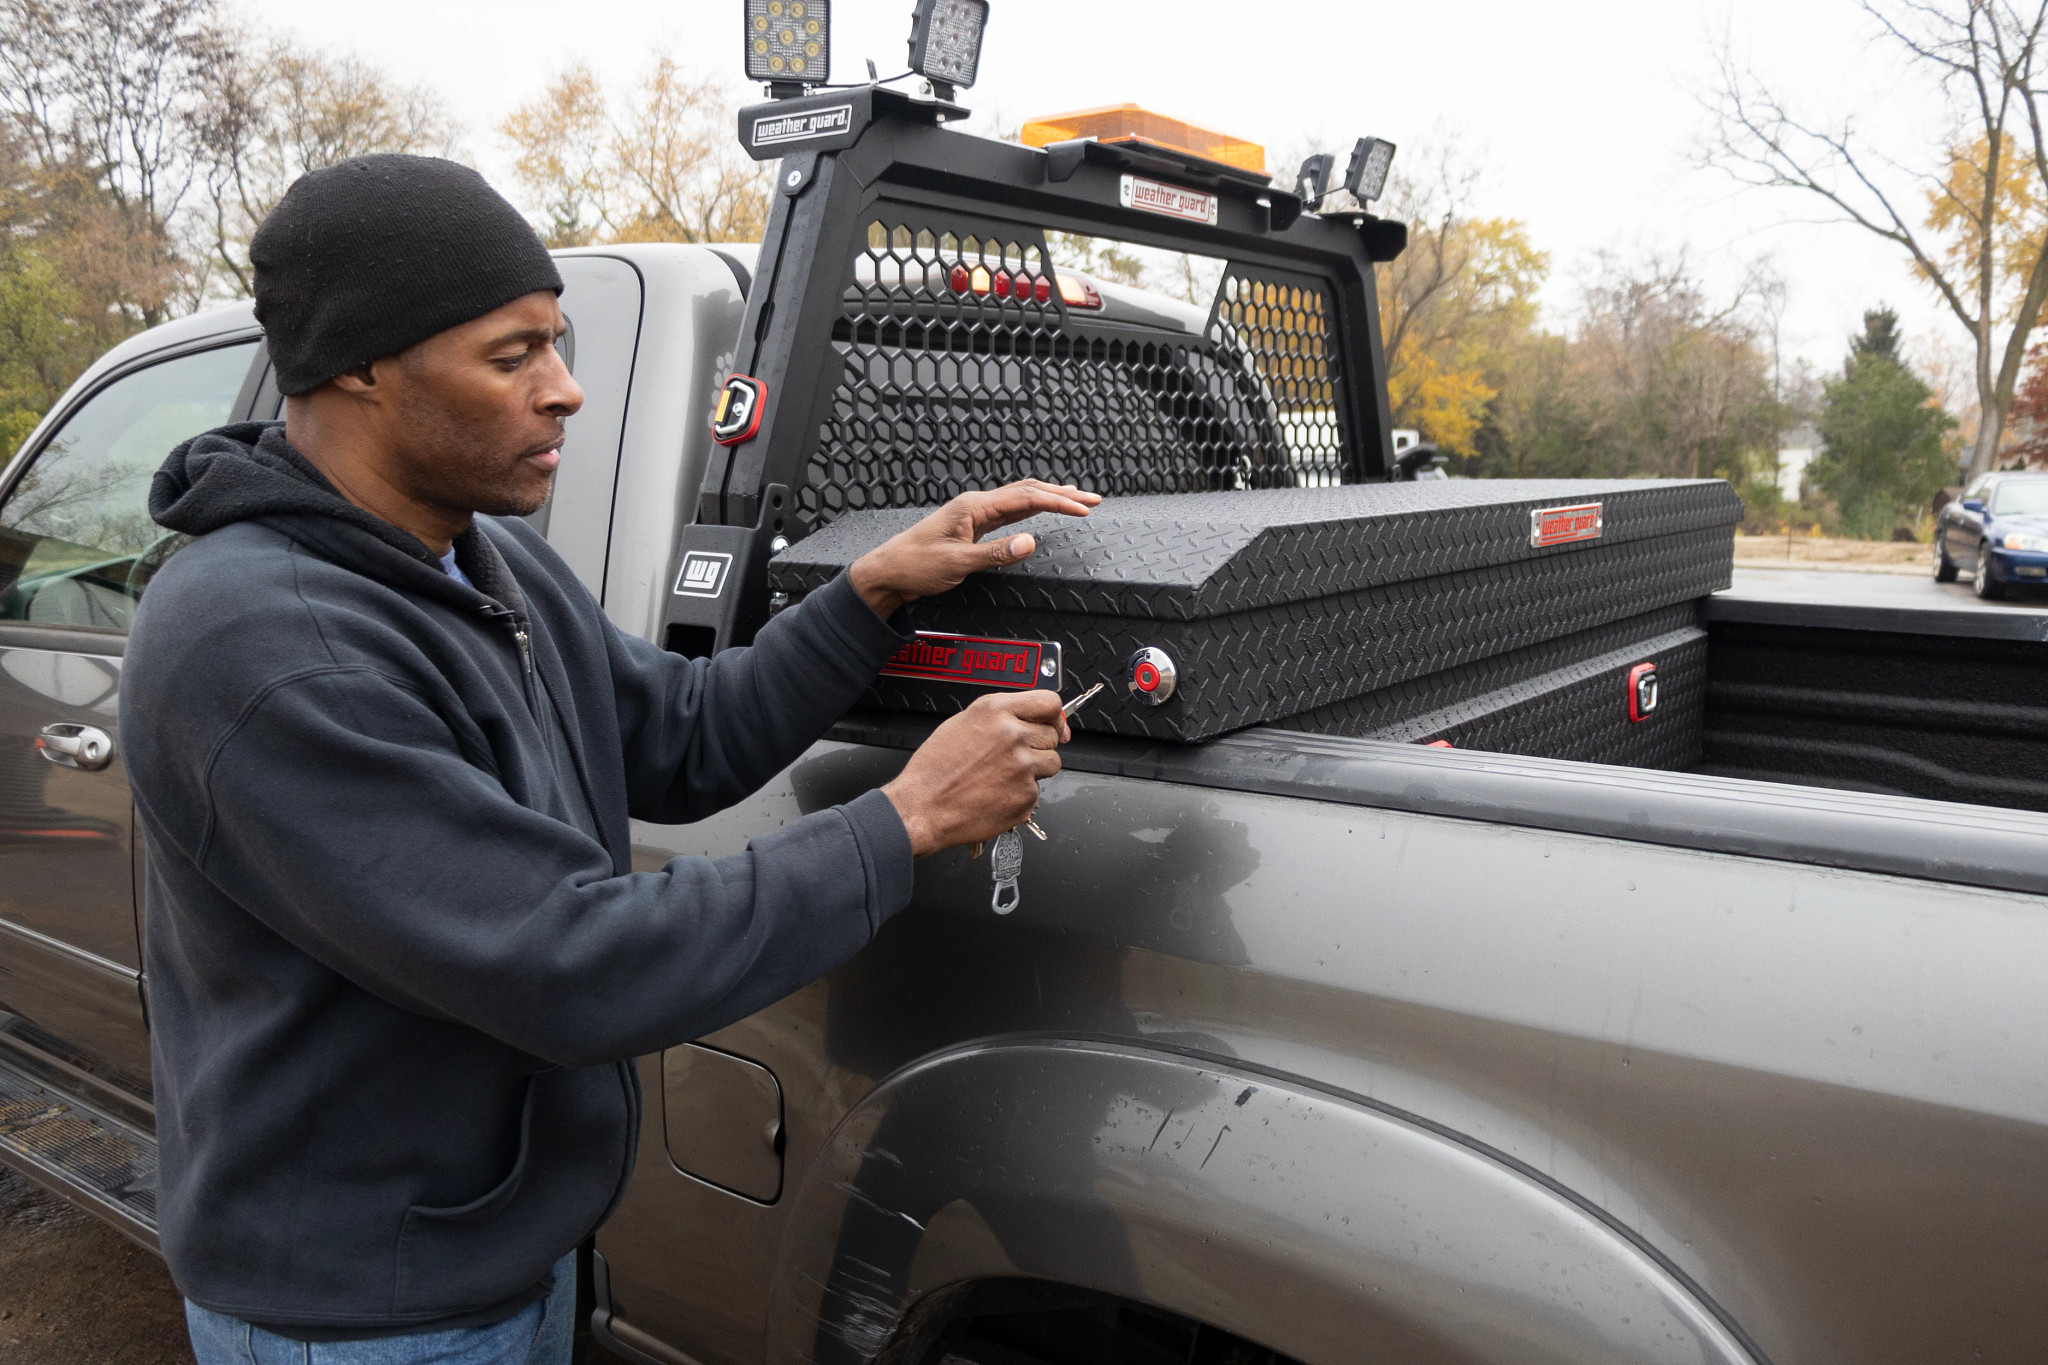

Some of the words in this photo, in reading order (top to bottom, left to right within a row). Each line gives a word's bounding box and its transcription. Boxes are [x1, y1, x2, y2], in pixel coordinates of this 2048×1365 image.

[757, 118, 808, 138] weather
[1135, 185, 1177, 206] weather
[1178, 195, 1207, 213] guard
[1542, 514, 1575, 535] weather
[961, 649, 1029, 675] guard
